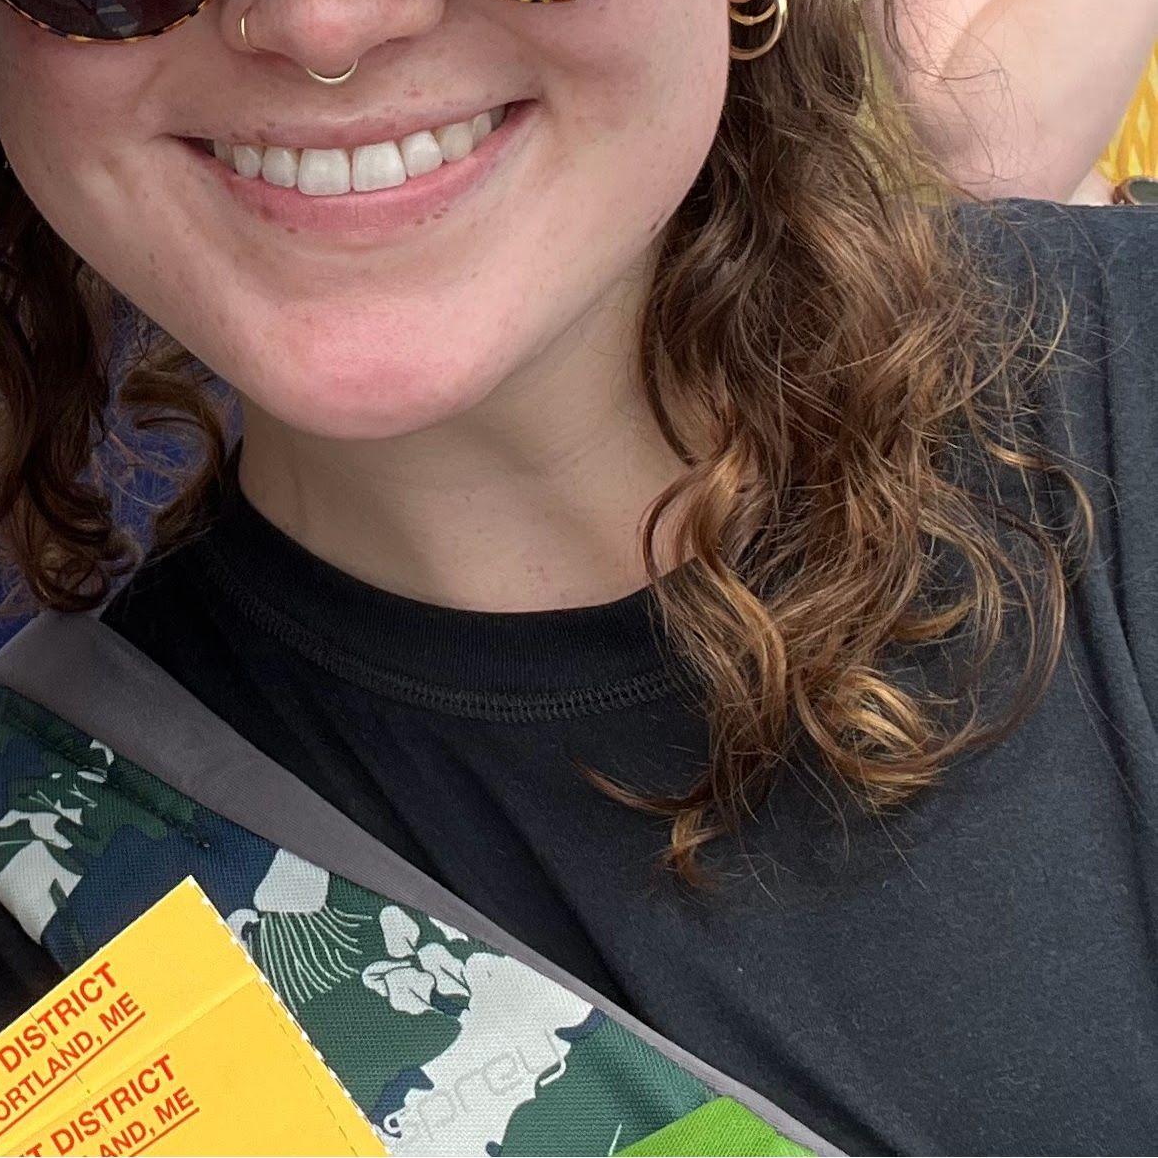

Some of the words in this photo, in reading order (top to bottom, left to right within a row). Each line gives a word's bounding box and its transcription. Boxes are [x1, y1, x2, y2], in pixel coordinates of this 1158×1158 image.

[98, 992, 140, 1033] ME
[50, 1053, 175, 1156] DISTRICT
[99, 1121, 156, 1157] AND,
[153, 1086, 194, 1125] ME
